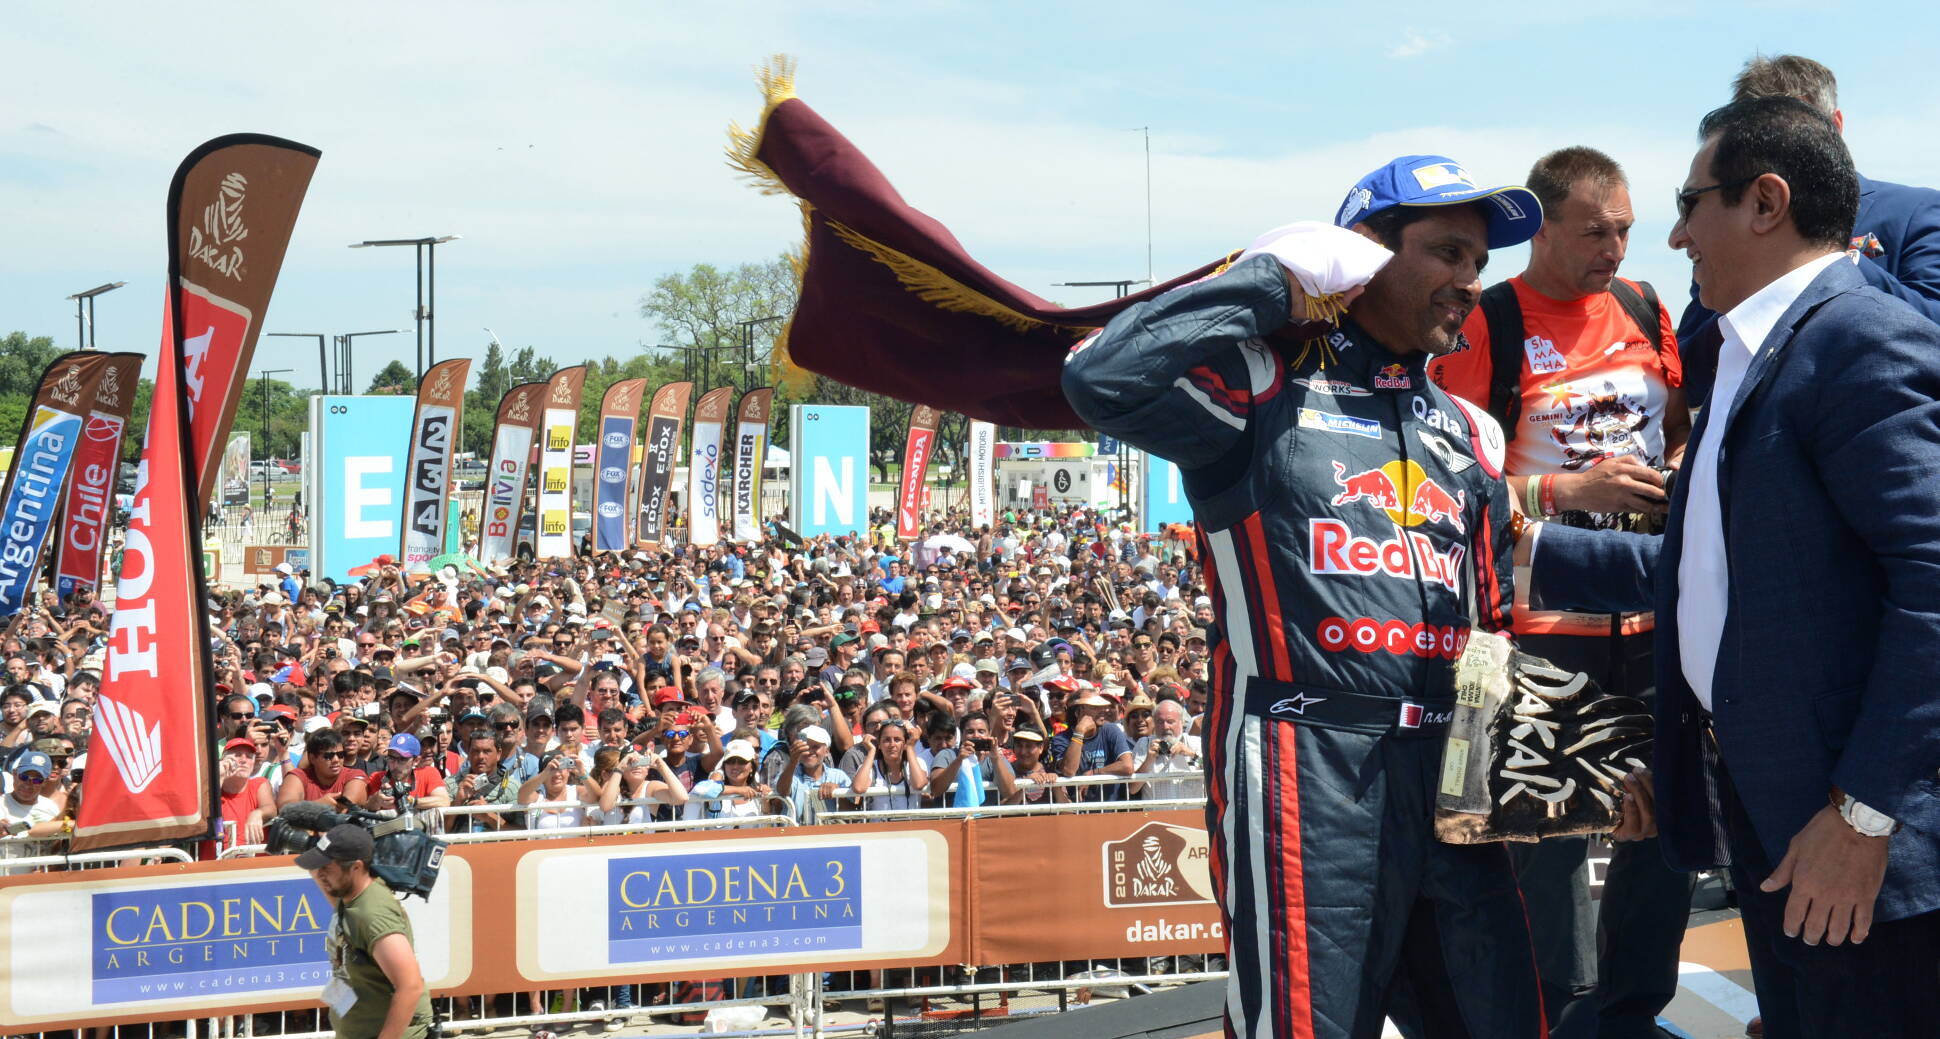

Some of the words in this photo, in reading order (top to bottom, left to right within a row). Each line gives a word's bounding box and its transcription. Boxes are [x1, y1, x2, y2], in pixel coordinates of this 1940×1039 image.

[189, 226, 243, 281] DAKAR
[430, 388, 450, 401] DAKAR
[1312, 384, 1352, 395] WORKS
[1375, 376, 1393, 388] Red
[1393, 376, 1411, 389] Bull
[51, 388, 79, 407] DAKAR
[552, 393, 572, 405] DAKAR
[508, 409, 529, 422] DAKAR
[1327, 418, 1378, 433] MICHELIN
[1529, 413, 1563, 423] GEMINI
[426, 422, 446, 447] 2
[551, 437, 570, 447] info
[978, 430, 987, 460] MOTORS
[656, 426, 671, 474] EDOX
[422, 465, 442, 489] 3
[547, 479, 567, 490] info
[700, 444, 717, 518] sodexo
[907, 434, 928, 508] HONDA
[978, 462, 986, 505] MITSUBISHI
[345, 456, 393, 539] E
[488, 459, 517, 537] Bolivia
[814, 456, 855, 525] N
[70, 463, 107, 551] Chile
[418, 504, 437, 530] 4
[648, 485, 661, 534] EDOX
[545, 521, 566, 532] info
[1310, 518, 1416, 579] Red
[1500, 663, 1588, 806] DAKAR
[620, 864, 811, 908] CADENA
[825, 861, 845, 898] 3
[1114, 850, 1126, 898] 2015
[1132, 877, 1177, 897] DAKAR
[106, 893, 320, 945] CADENA
[621, 903, 854, 931] ARGENTINA
[107, 937, 329, 969] ARGENTI
[651, 934, 827, 955] www.cadena3.com
